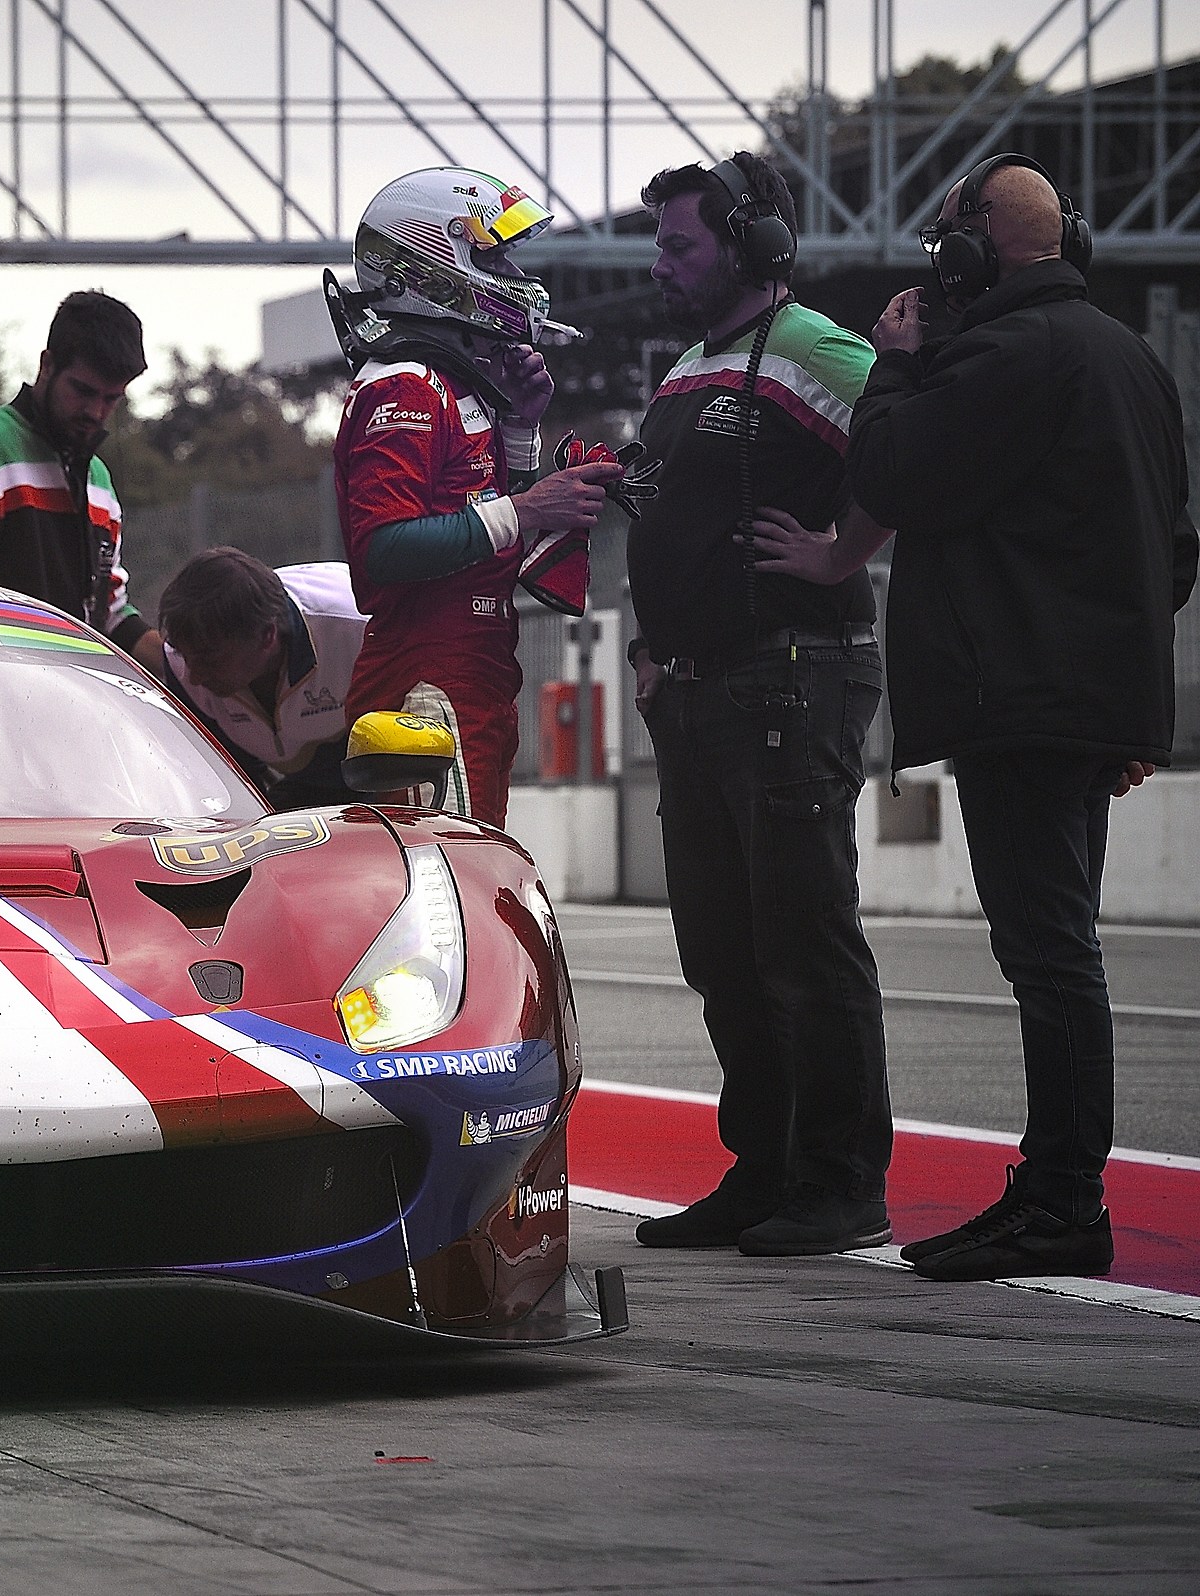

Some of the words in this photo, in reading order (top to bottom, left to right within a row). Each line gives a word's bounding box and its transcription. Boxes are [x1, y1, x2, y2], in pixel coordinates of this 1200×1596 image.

[472, 599, 497, 613] OMP
[376, 1056, 440, 1079] SMP
[442, 1049, 518, 1077] RACING
[494, 1103, 550, 1132] MICHELIN
[518, 1185, 564, 1217] V-Power
